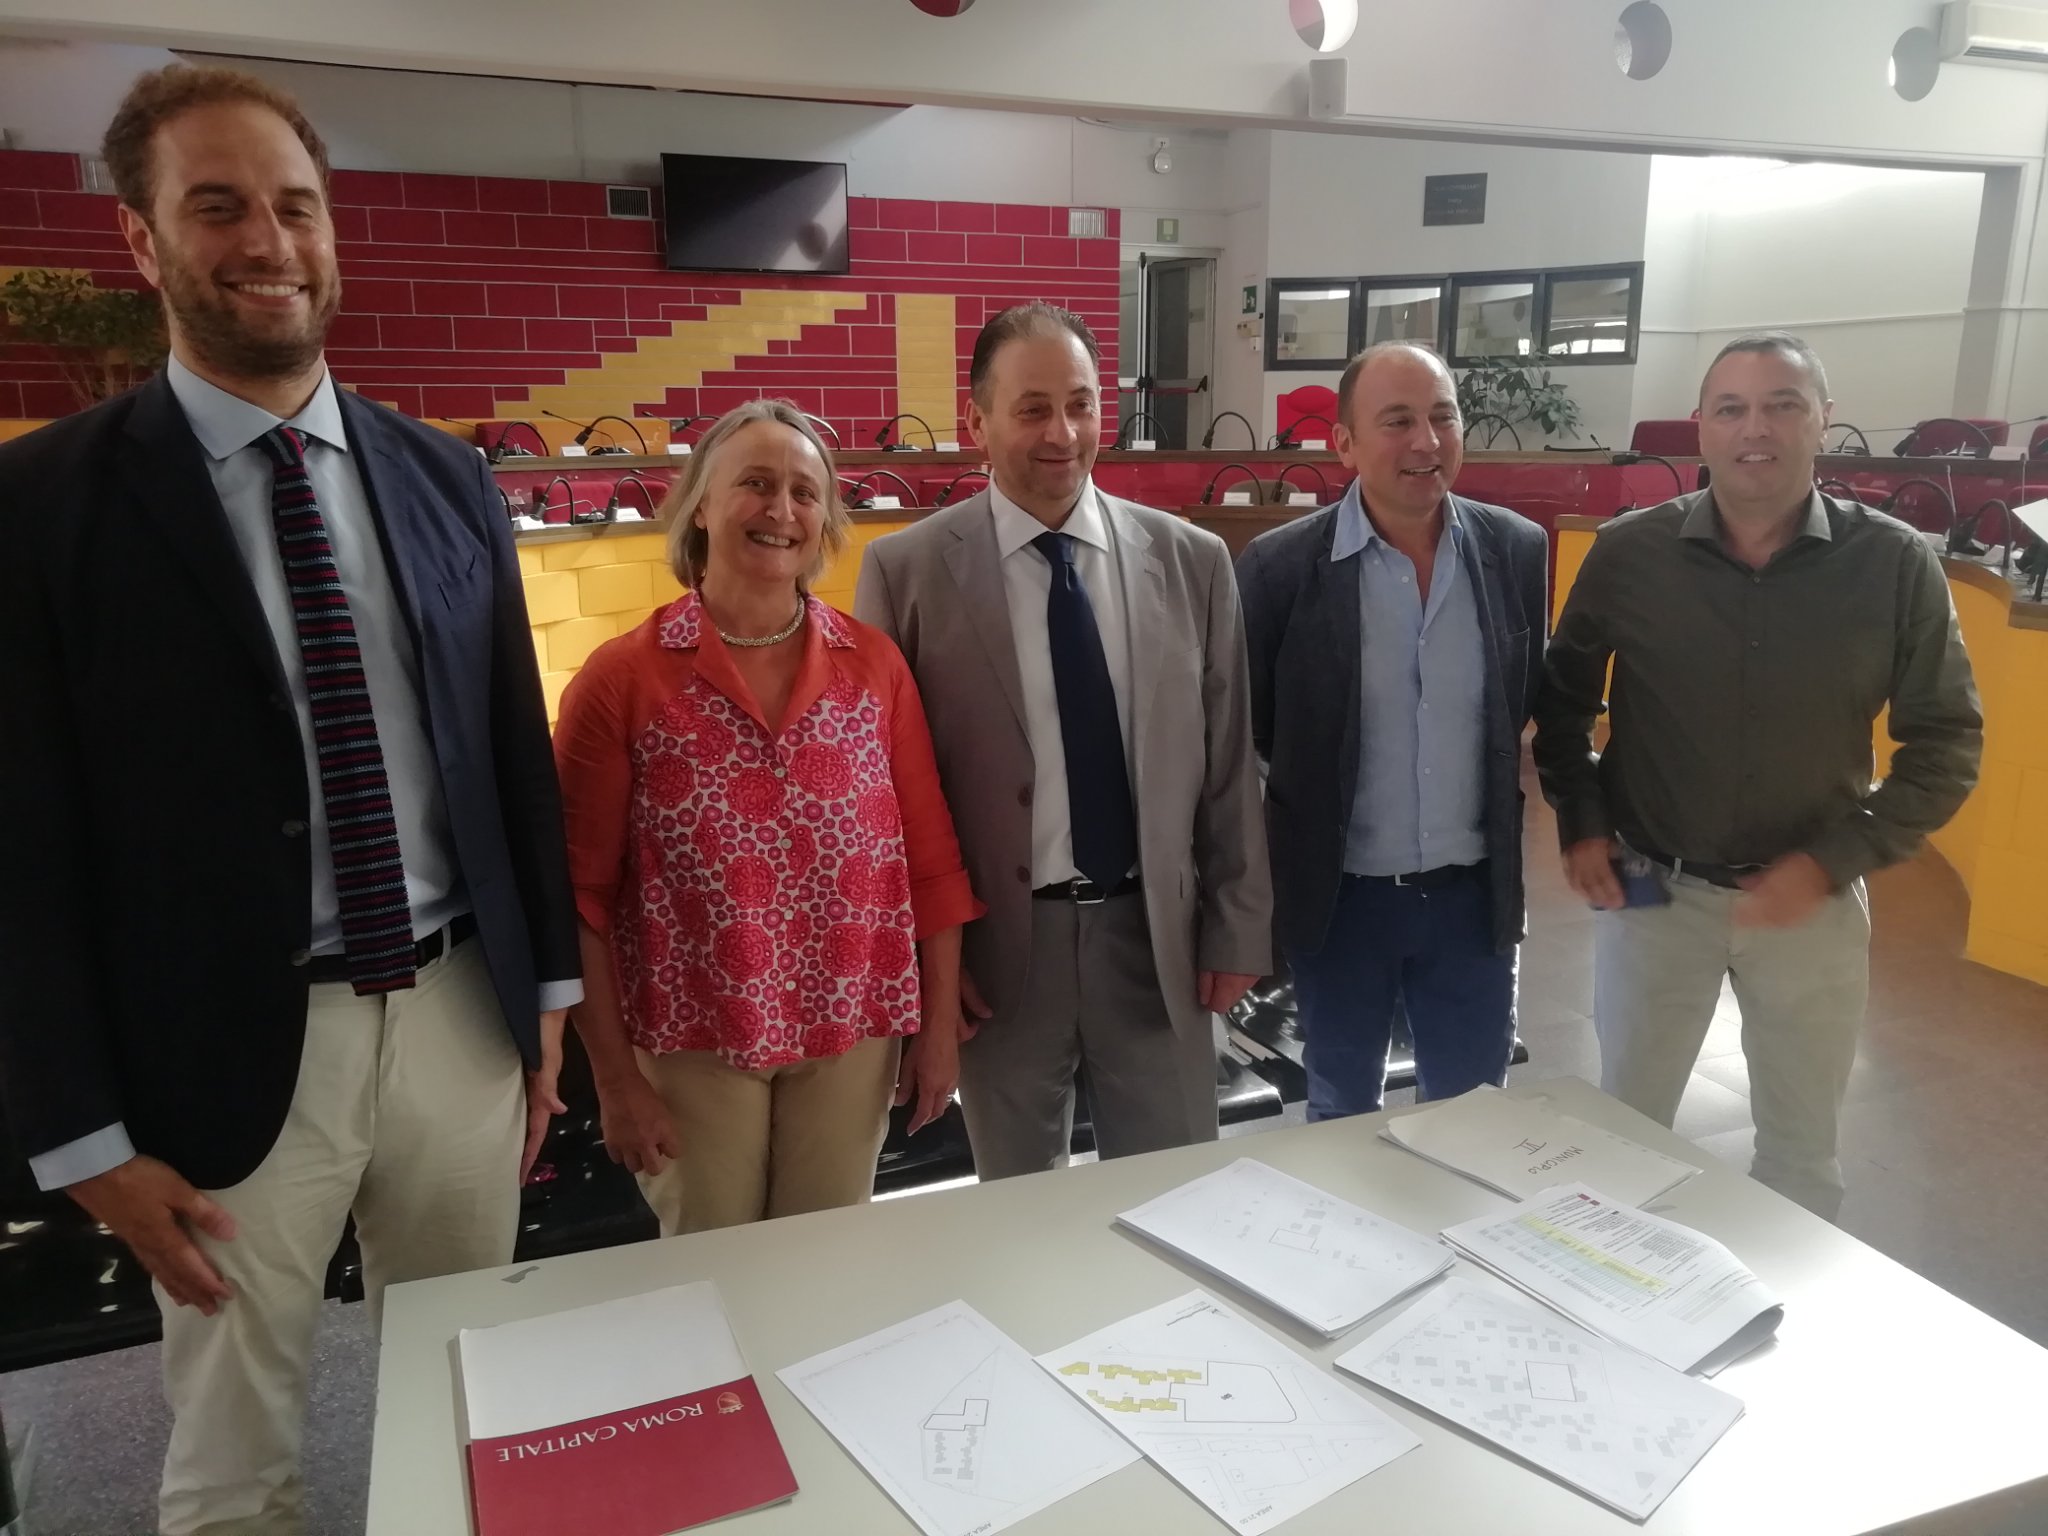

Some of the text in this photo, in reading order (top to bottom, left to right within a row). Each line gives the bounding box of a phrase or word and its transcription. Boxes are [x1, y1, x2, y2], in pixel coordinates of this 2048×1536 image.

[1527, 1145, 1584, 1175] MUNICIPIO
[495, 1402, 704, 1462] ROMA CAPITALE
